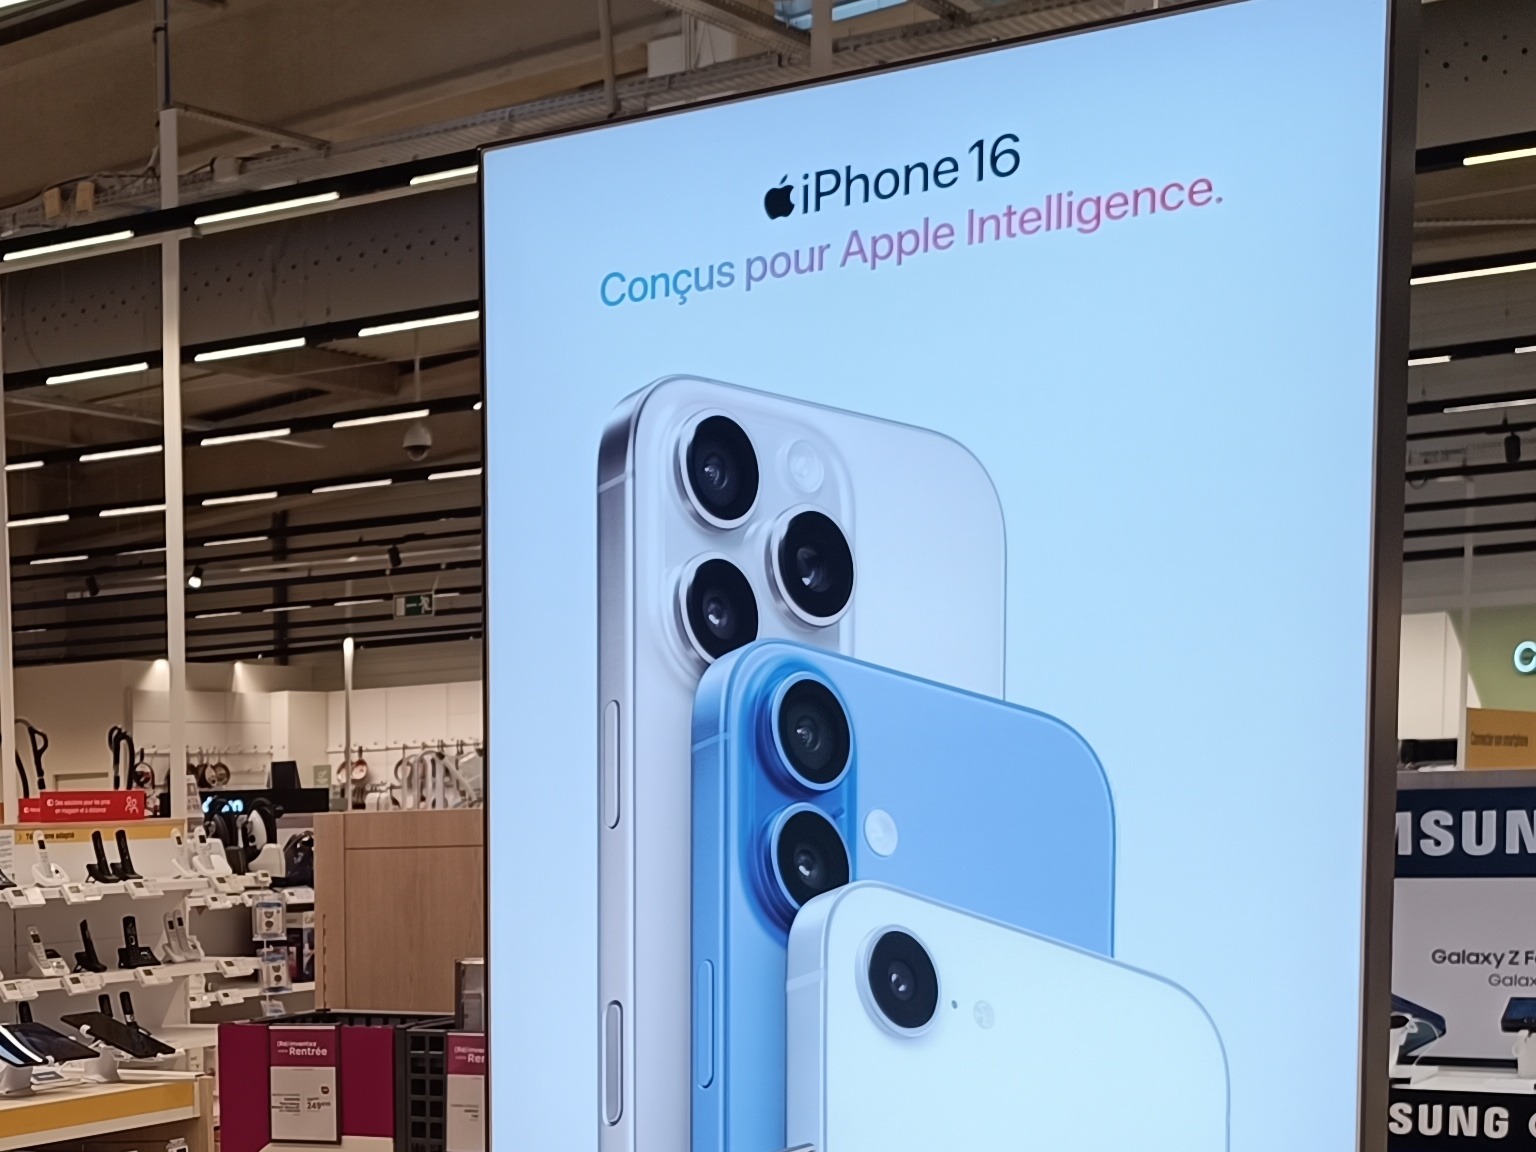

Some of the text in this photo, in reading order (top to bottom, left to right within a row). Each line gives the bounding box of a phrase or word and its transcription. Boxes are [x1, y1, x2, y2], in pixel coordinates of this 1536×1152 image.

[800, 132, 1022, 214] iPhone 16
[600, 174, 1224, 307] Conçus pour Apple Intelligence.
[1432, 949, 1536, 969] Galaxy Z F
[289, 1047, 327, 1056] Rentrée
